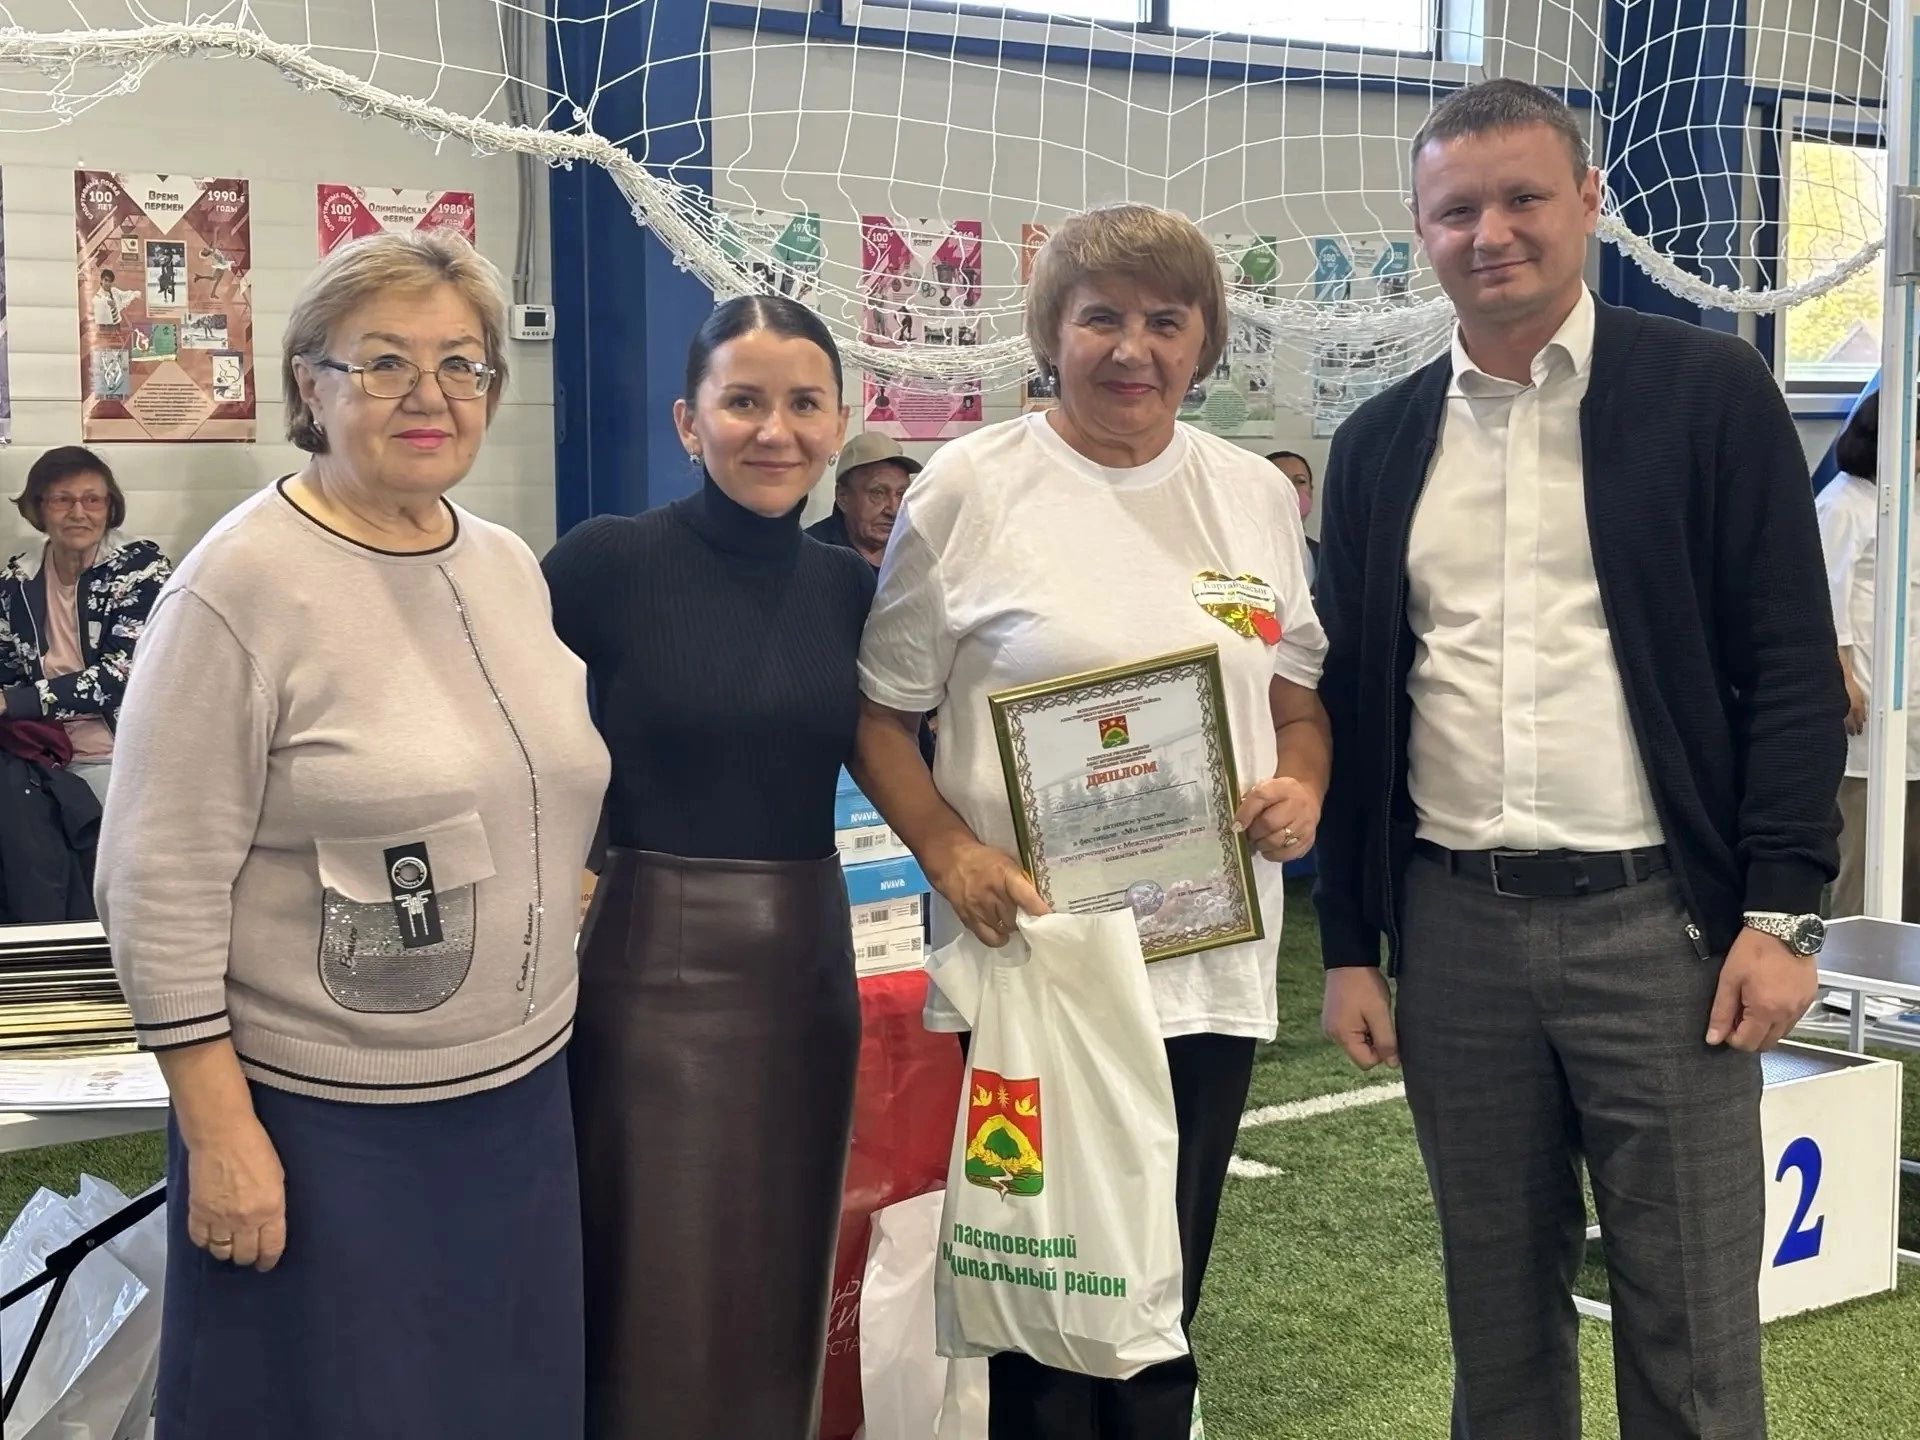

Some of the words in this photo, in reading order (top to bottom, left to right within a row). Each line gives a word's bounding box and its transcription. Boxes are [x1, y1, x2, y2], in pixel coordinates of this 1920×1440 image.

[89, 191, 113, 203] 100
[98, 203, 113, 211] ЛЕТ
[144, 202, 184, 212] ПЕРЕМЕН
[331, 203, 352, 215] 100
[368, 202, 427, 214] ОЛИМПИЙСКАЯ
[382, 215, 414, 224] ФЕЕРИЯ
[872, 232, 889, 243] 100
[1086, 761, 1158, 790] ДИПЛОМ
[1772, 1136, 1825, 1268] 2
[953, 1222, 1077, 1259] пастовский
[1064, 1270, 1126, 1298] район
